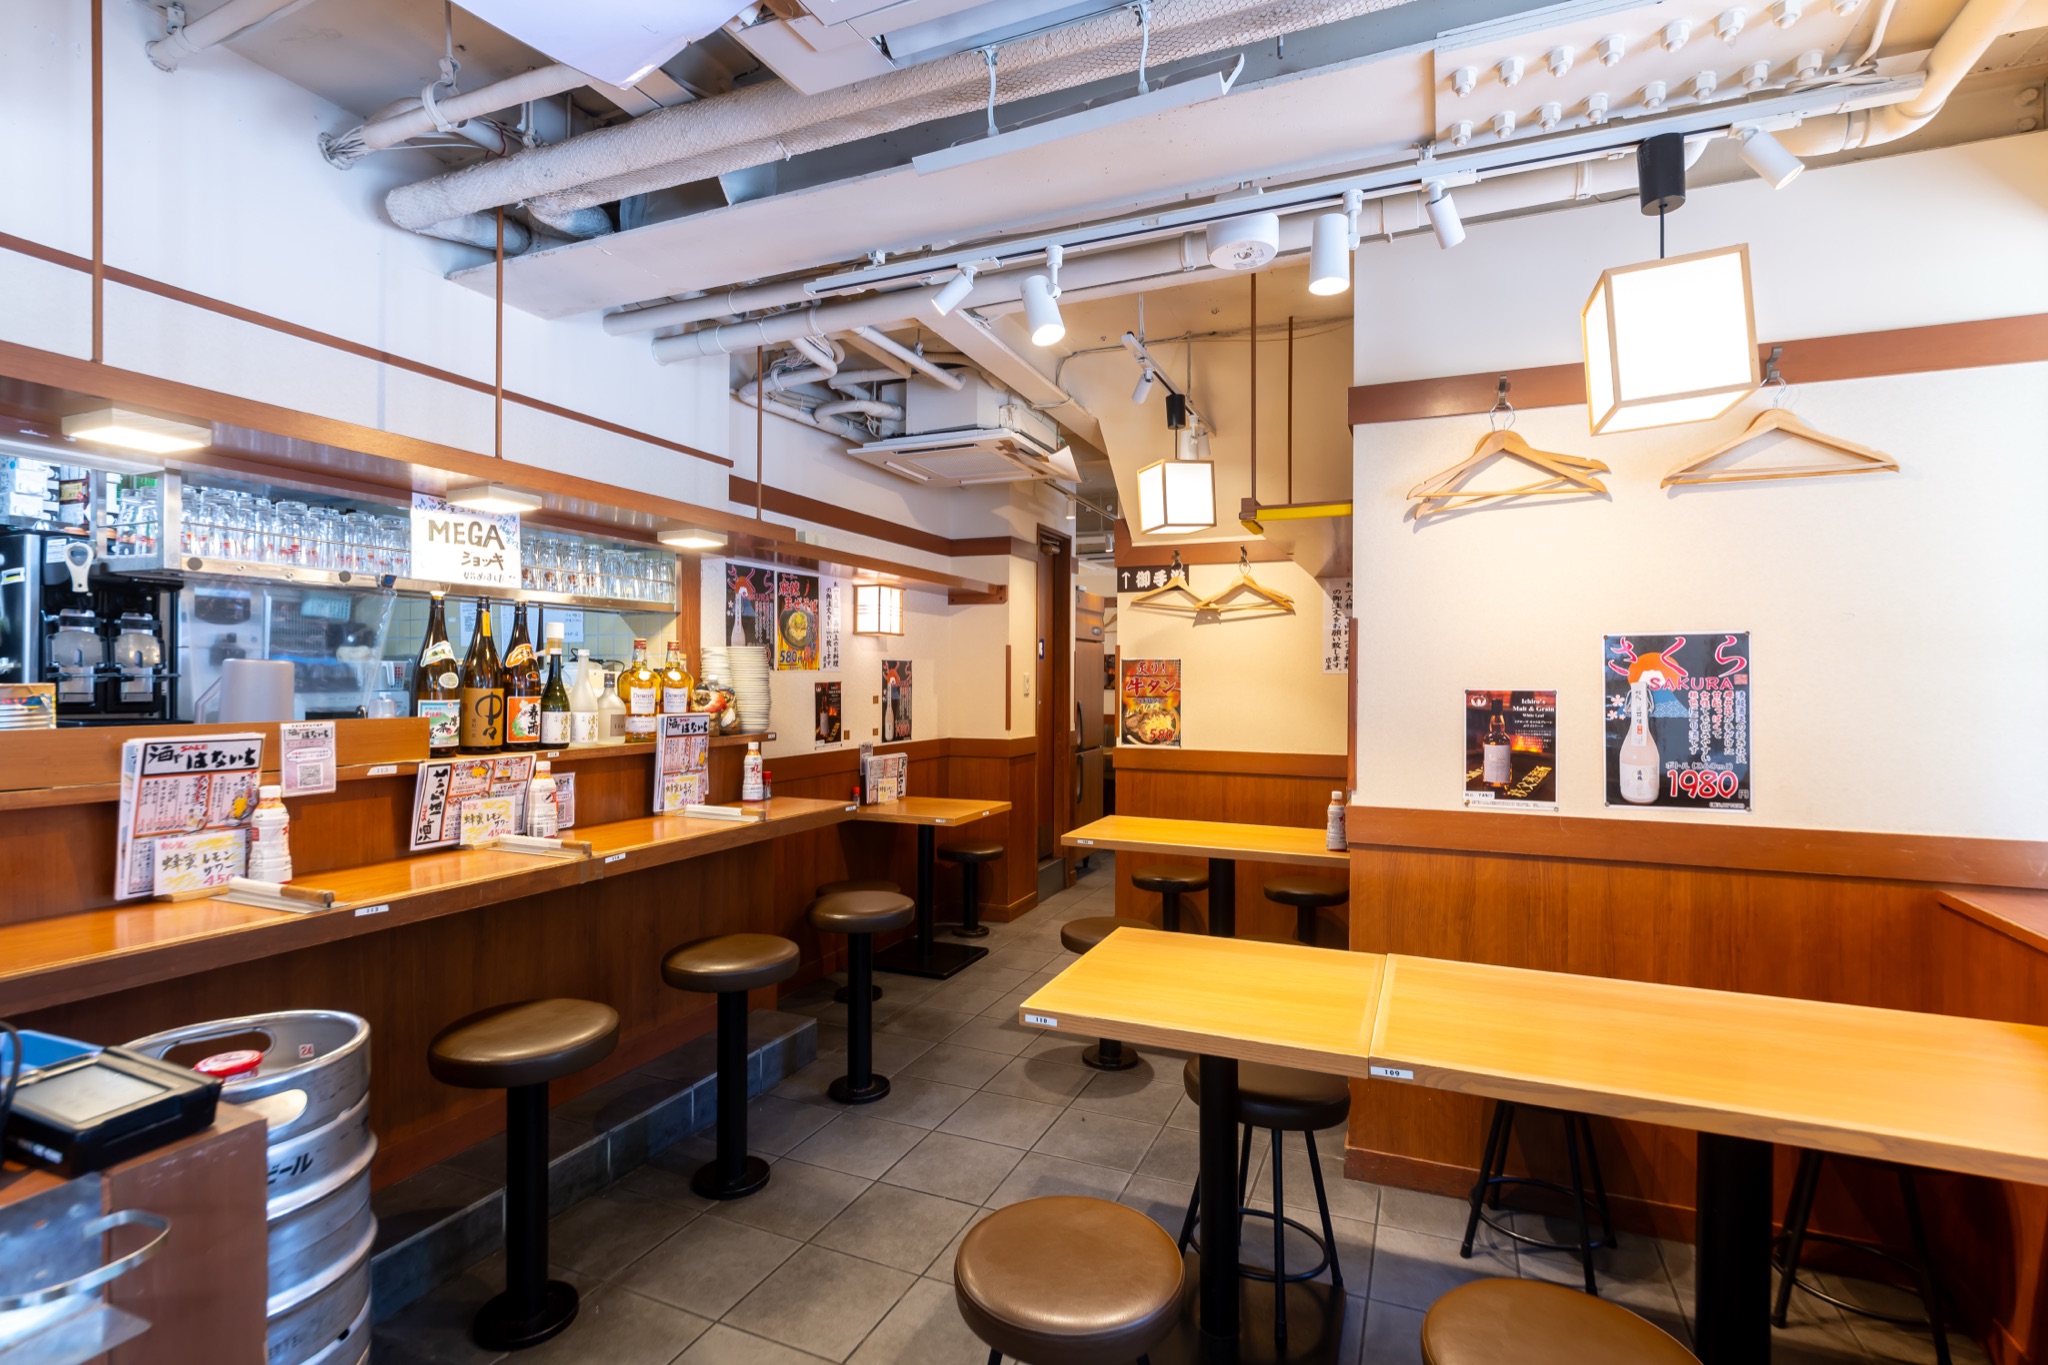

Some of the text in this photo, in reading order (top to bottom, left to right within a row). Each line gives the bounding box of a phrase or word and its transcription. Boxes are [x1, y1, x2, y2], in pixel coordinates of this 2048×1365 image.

[428, 519, 506, 550] MEGA
[461, 551, 504, 571] ジョッキ
[784, 596, 818, 613] まぜそば
[1607, 636, 1747, 678] さくら
[1126, 677, 1177, 696] 牛タン
[1650, 676, 1735, 690] SAKURA
[528, 704, 539, 736] 春雨
[1150, 728, 1174, 741] 580
[1667, 769, 1739, 799] 1980
[203, 851, 235, 863] レモン
[204, 863, 235, 876] サワー
